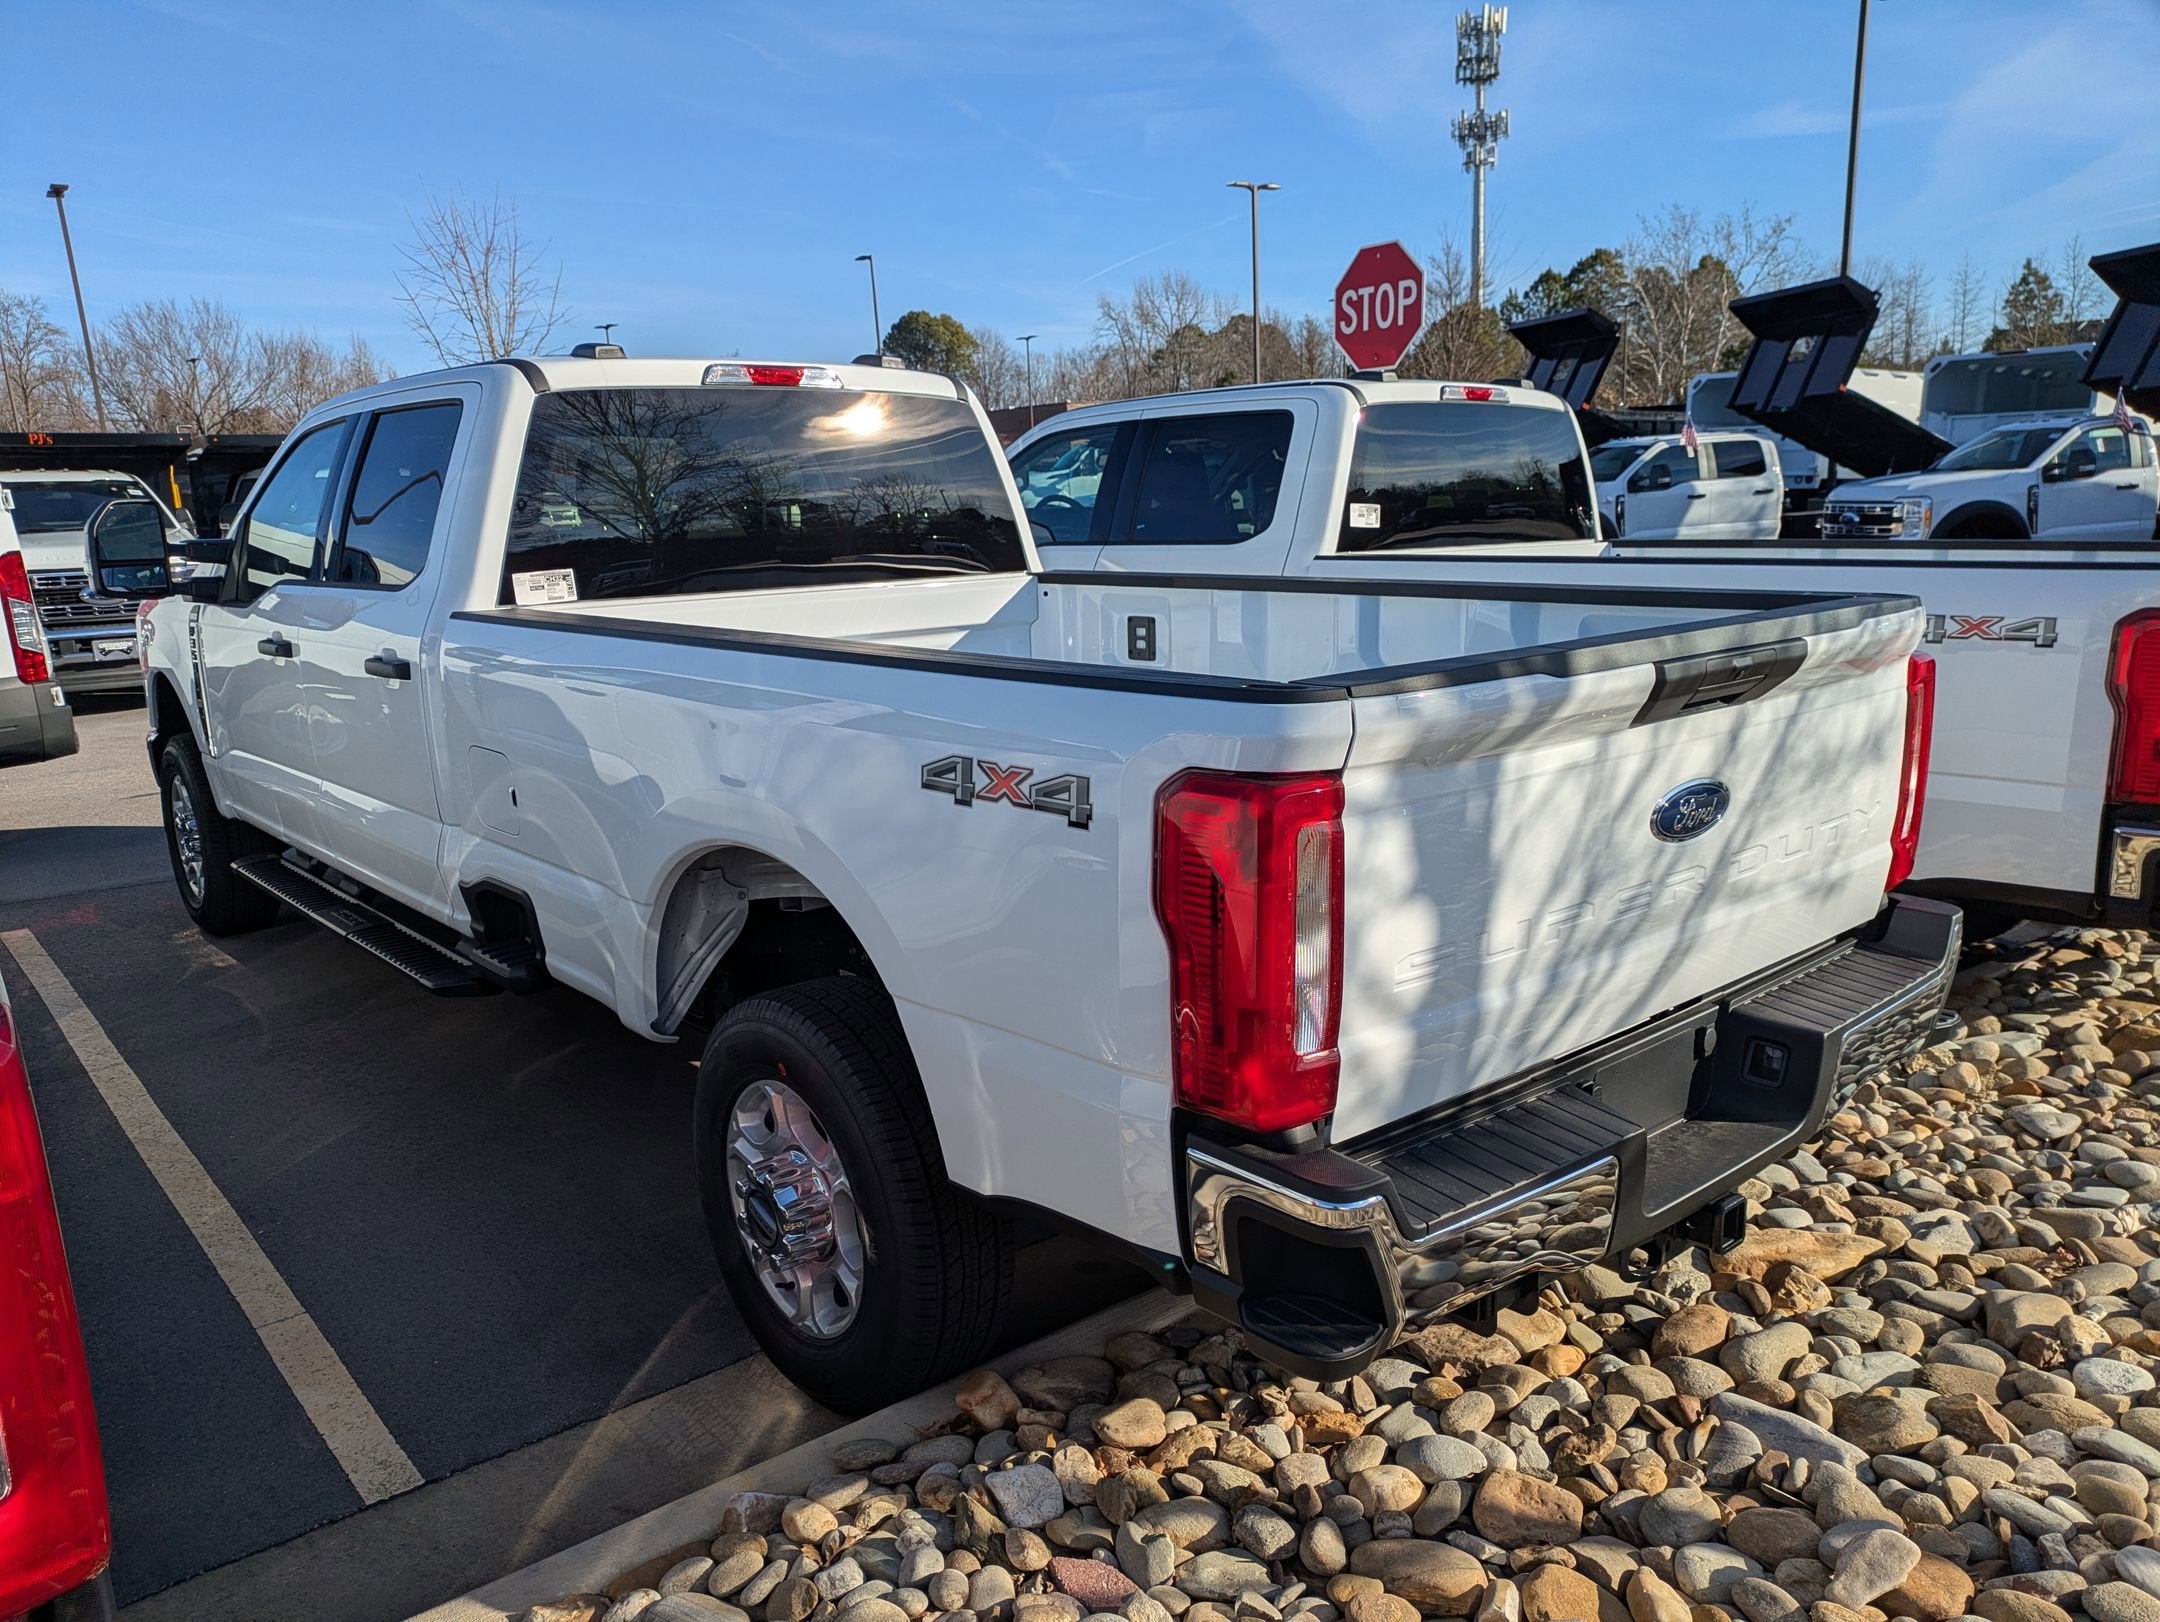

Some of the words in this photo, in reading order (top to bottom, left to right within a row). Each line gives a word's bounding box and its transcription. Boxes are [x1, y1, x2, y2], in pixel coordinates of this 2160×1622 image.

[1339, 278, 1418, 335] STOP
[28, 432, 54, 445] PJ's
[1673, 792, 1718, 831] Ford
[1393, 865, 1706, 992] SUPER
[1728, 801, 1880, 883] DUTY
